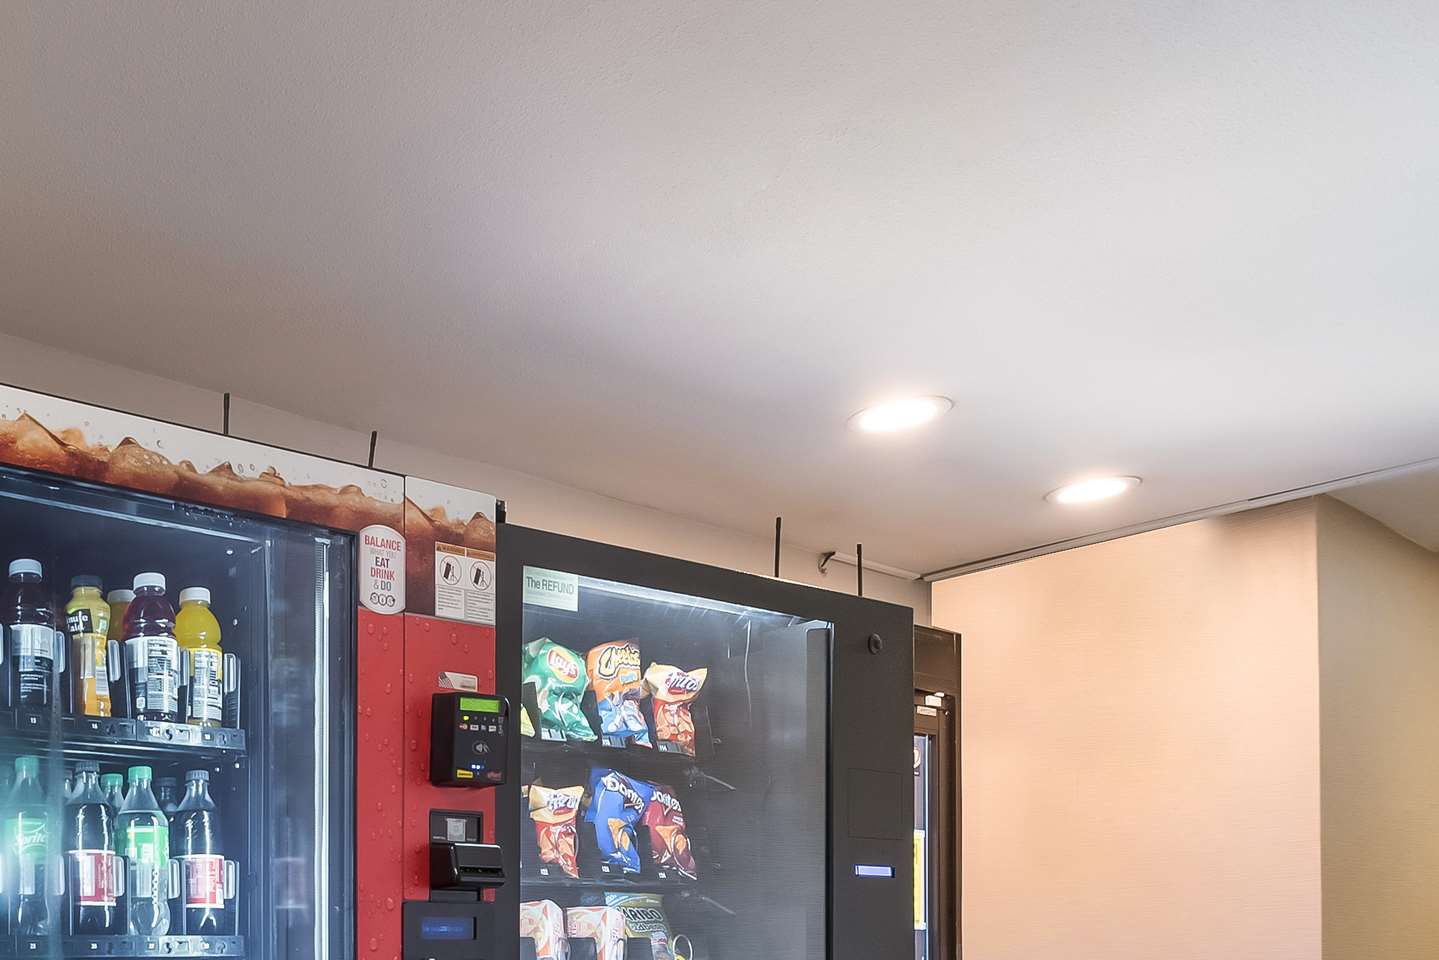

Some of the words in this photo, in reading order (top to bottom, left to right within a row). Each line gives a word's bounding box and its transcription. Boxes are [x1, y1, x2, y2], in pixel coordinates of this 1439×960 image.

[364, 535, 401, 551] BALANCE
[375, 556, 390, 569] EAT
[370, 567, 395, 581] DRINK
[380, 580, 392, 592] DO
[526, 576, 541, 590] The
[541, 578, 575, 594] REFUND
[618, 906, 664, 921] ARIBO
